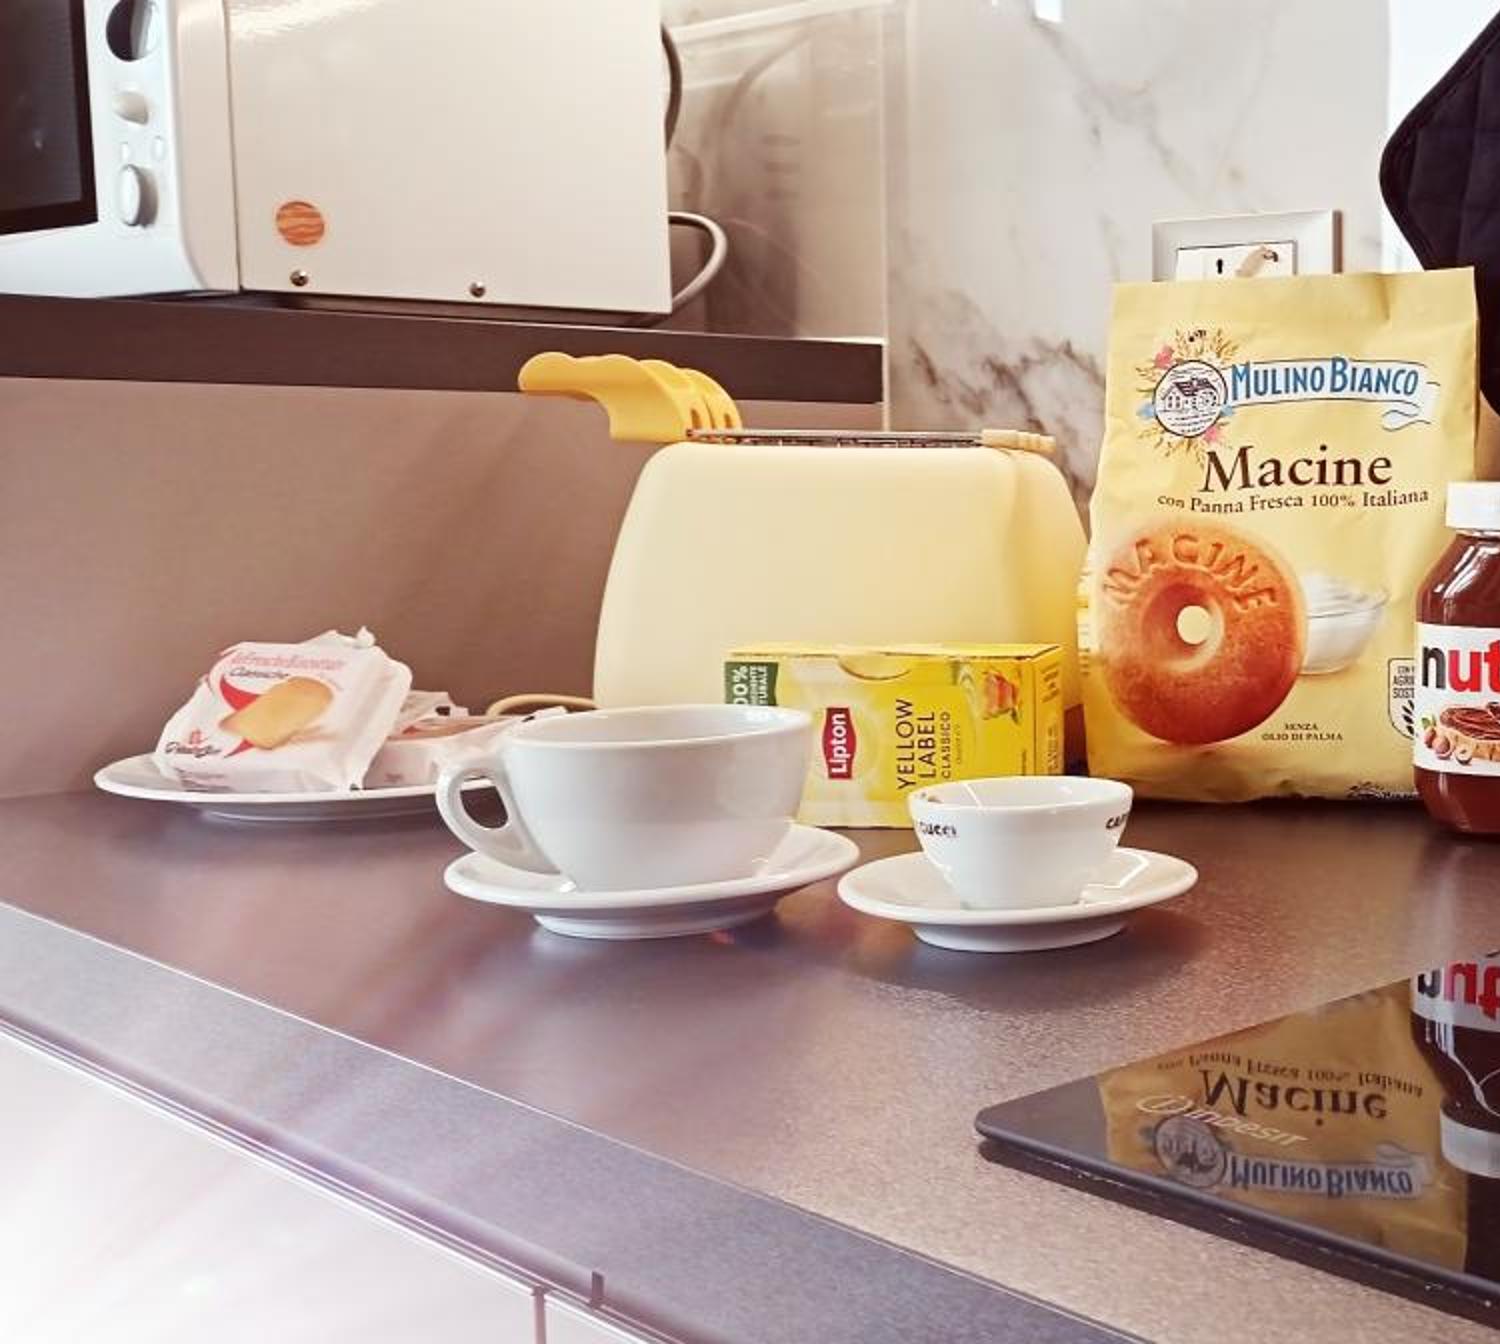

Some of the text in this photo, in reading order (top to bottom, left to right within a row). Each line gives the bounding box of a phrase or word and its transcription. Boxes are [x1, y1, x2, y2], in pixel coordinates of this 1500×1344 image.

[1231, 356, 1419, 401] MULINO BIANCO
[1199, 444, 1393, 493] Macine
[1157, 489, 1429, 514] con Panna Fresca 100% Italiana
[732, 665, 749, 704] 00%
[829, 713, 852, 773] Lipton
[896, 698, 917, 790] YELLOW
[917, 711, 937, 779] LABEL
[940, 711, 952, 779] CLASSICO
[1261, 732, 1344, 741] OLIO DI PALMA
[1284, 722, 1319, 731] SENZA
